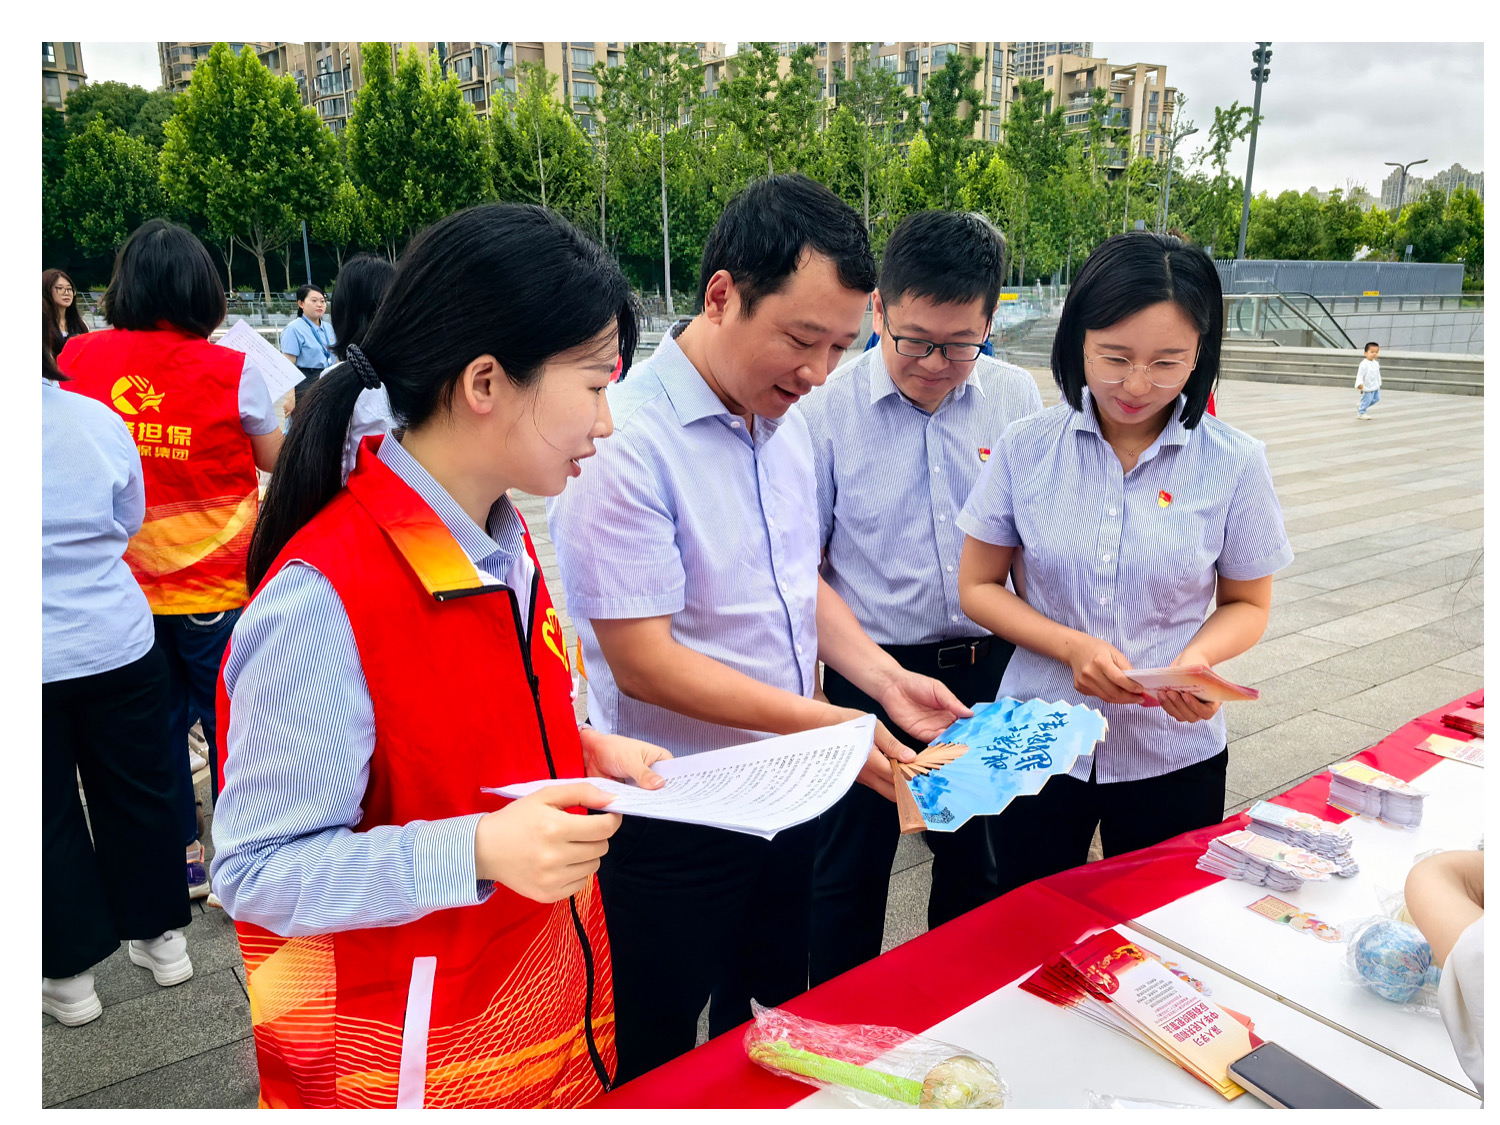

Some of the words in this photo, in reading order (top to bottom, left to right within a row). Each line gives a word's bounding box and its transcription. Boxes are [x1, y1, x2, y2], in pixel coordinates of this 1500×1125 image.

[1173, 1011, 1219, 1042] 中华人民共和国
[1192, 1025, 1223, 1047] 深入学习
